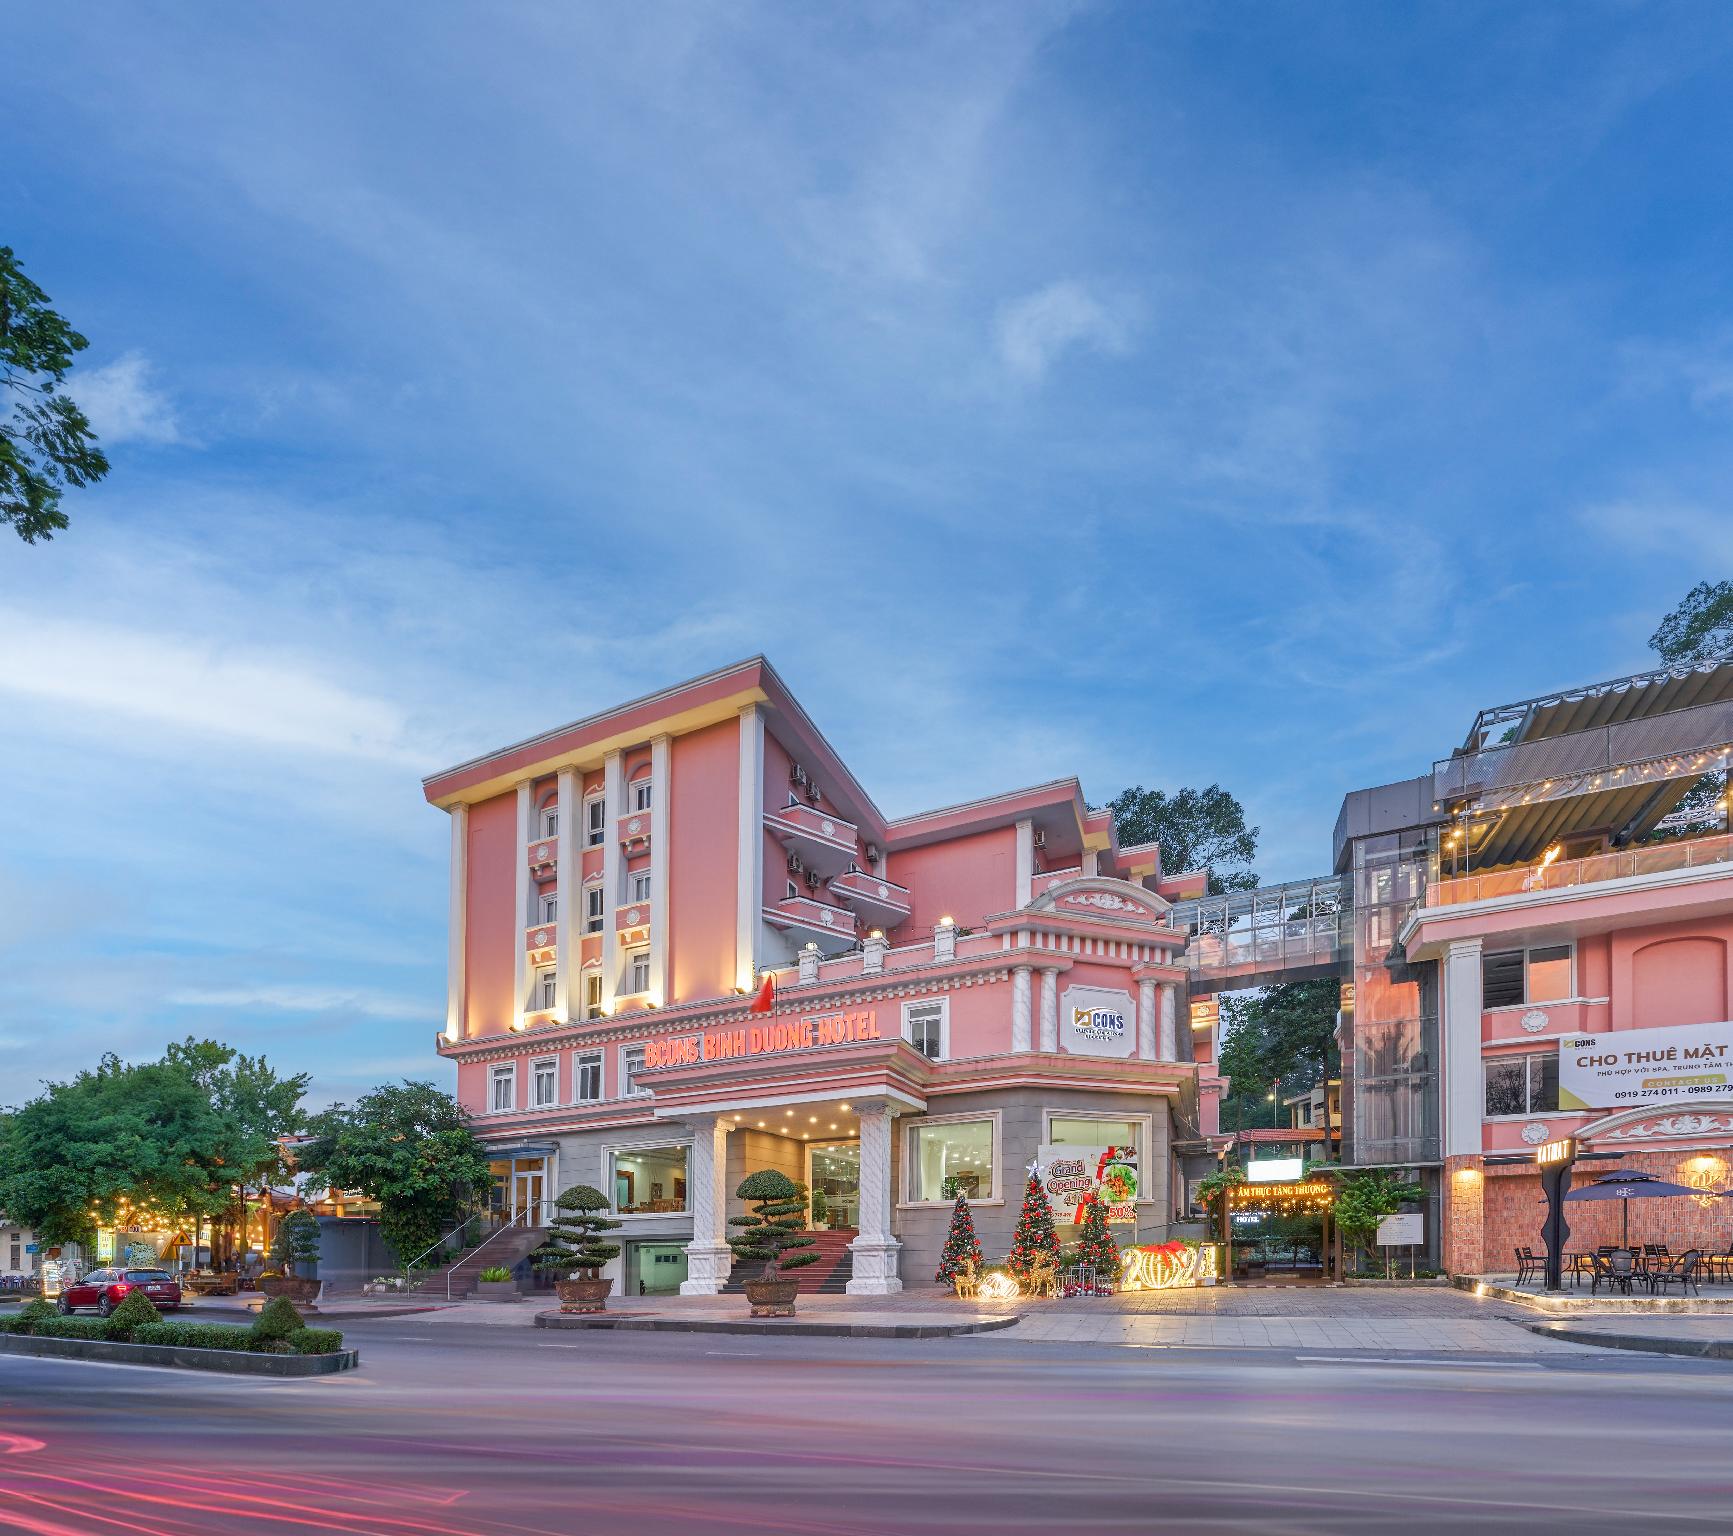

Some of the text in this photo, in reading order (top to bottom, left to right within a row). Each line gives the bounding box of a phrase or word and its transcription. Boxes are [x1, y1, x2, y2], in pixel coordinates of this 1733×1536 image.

[645, 1010, 881, 1068] BCONS BINH DUONG HOTEL
[1576, 1043, 1728, 1068] CHO THUÊ MẶT
[1615, 1090, 1638, 1099] 0919
[1641, 1088, 1659, 1097] 274
[1661, 1087, 1678, 1096] 011
[1688, 1085, 1712, 1094] 0989
[1715, 1084, 1733, 1092] 279
[1053, 1162, 1085, 1176] Grand
[1048, 1177, 1092, 1194] Opening
